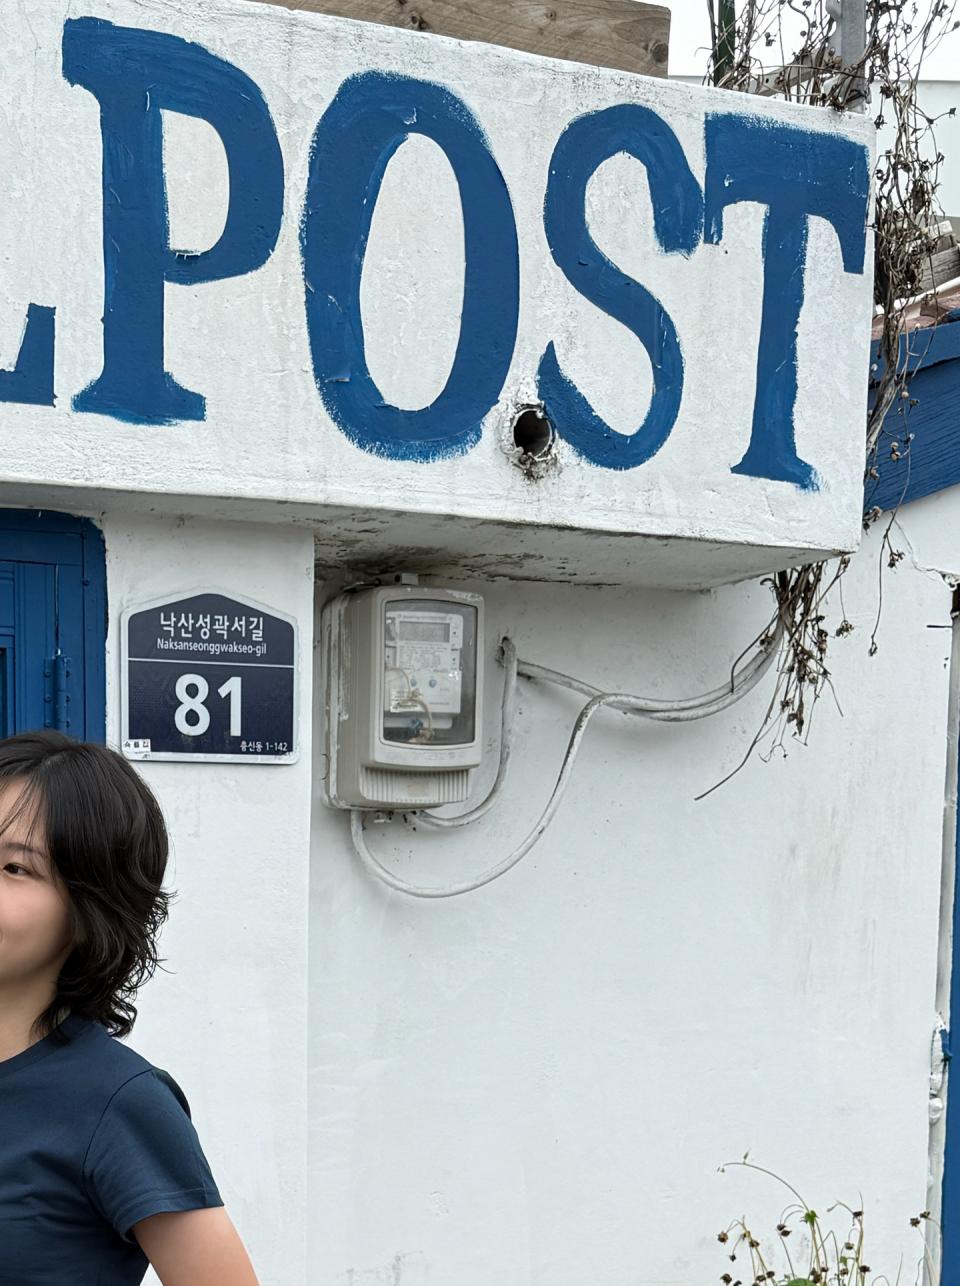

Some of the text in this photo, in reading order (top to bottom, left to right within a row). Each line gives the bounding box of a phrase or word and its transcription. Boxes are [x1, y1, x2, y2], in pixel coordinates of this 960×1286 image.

[160, 612, 263, 641] 낙산성곽서길
[157, 638, 267, 656] Naksanseonggwakseo-gil
[174, 673, 242, 737] 81
[265, 741, 288, 752] 1-142
